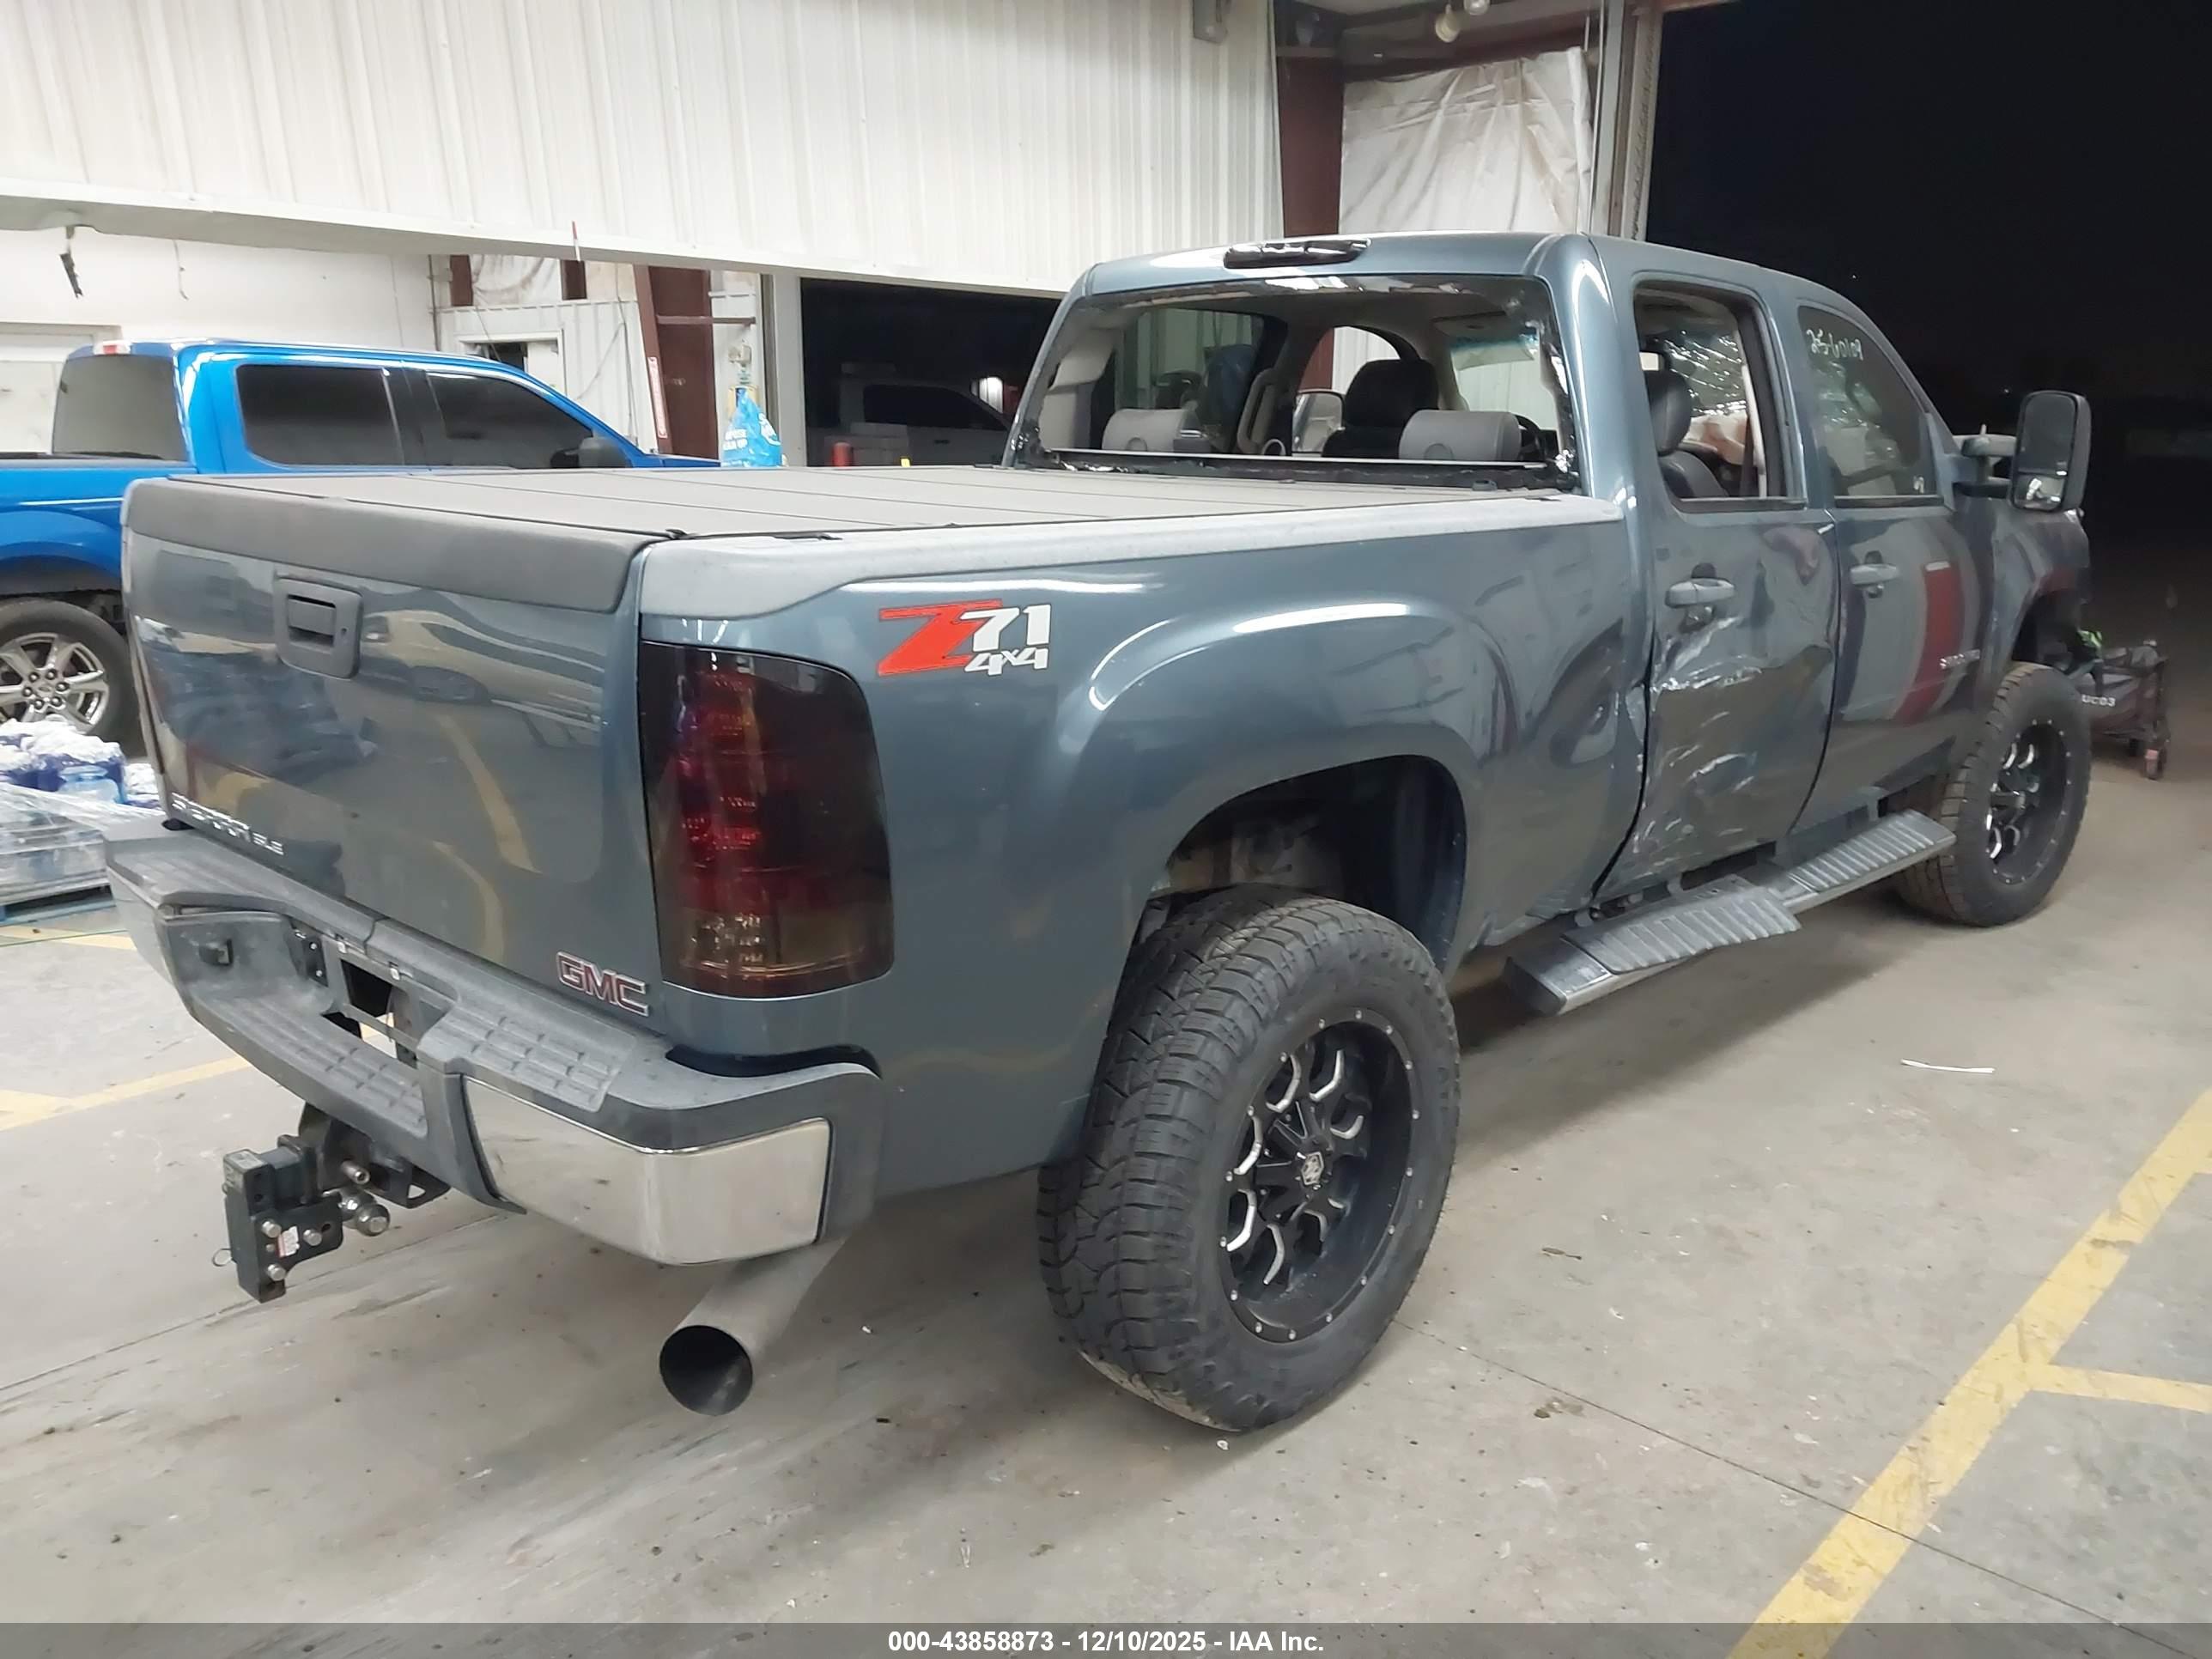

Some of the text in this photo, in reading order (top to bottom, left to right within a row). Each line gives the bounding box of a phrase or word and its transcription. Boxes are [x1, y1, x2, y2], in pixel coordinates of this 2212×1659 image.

[878, 598, 1051, 677] Z71
[963, 647, 1049, 676] 4x4
[556, 951, 649, 1018] GMC
